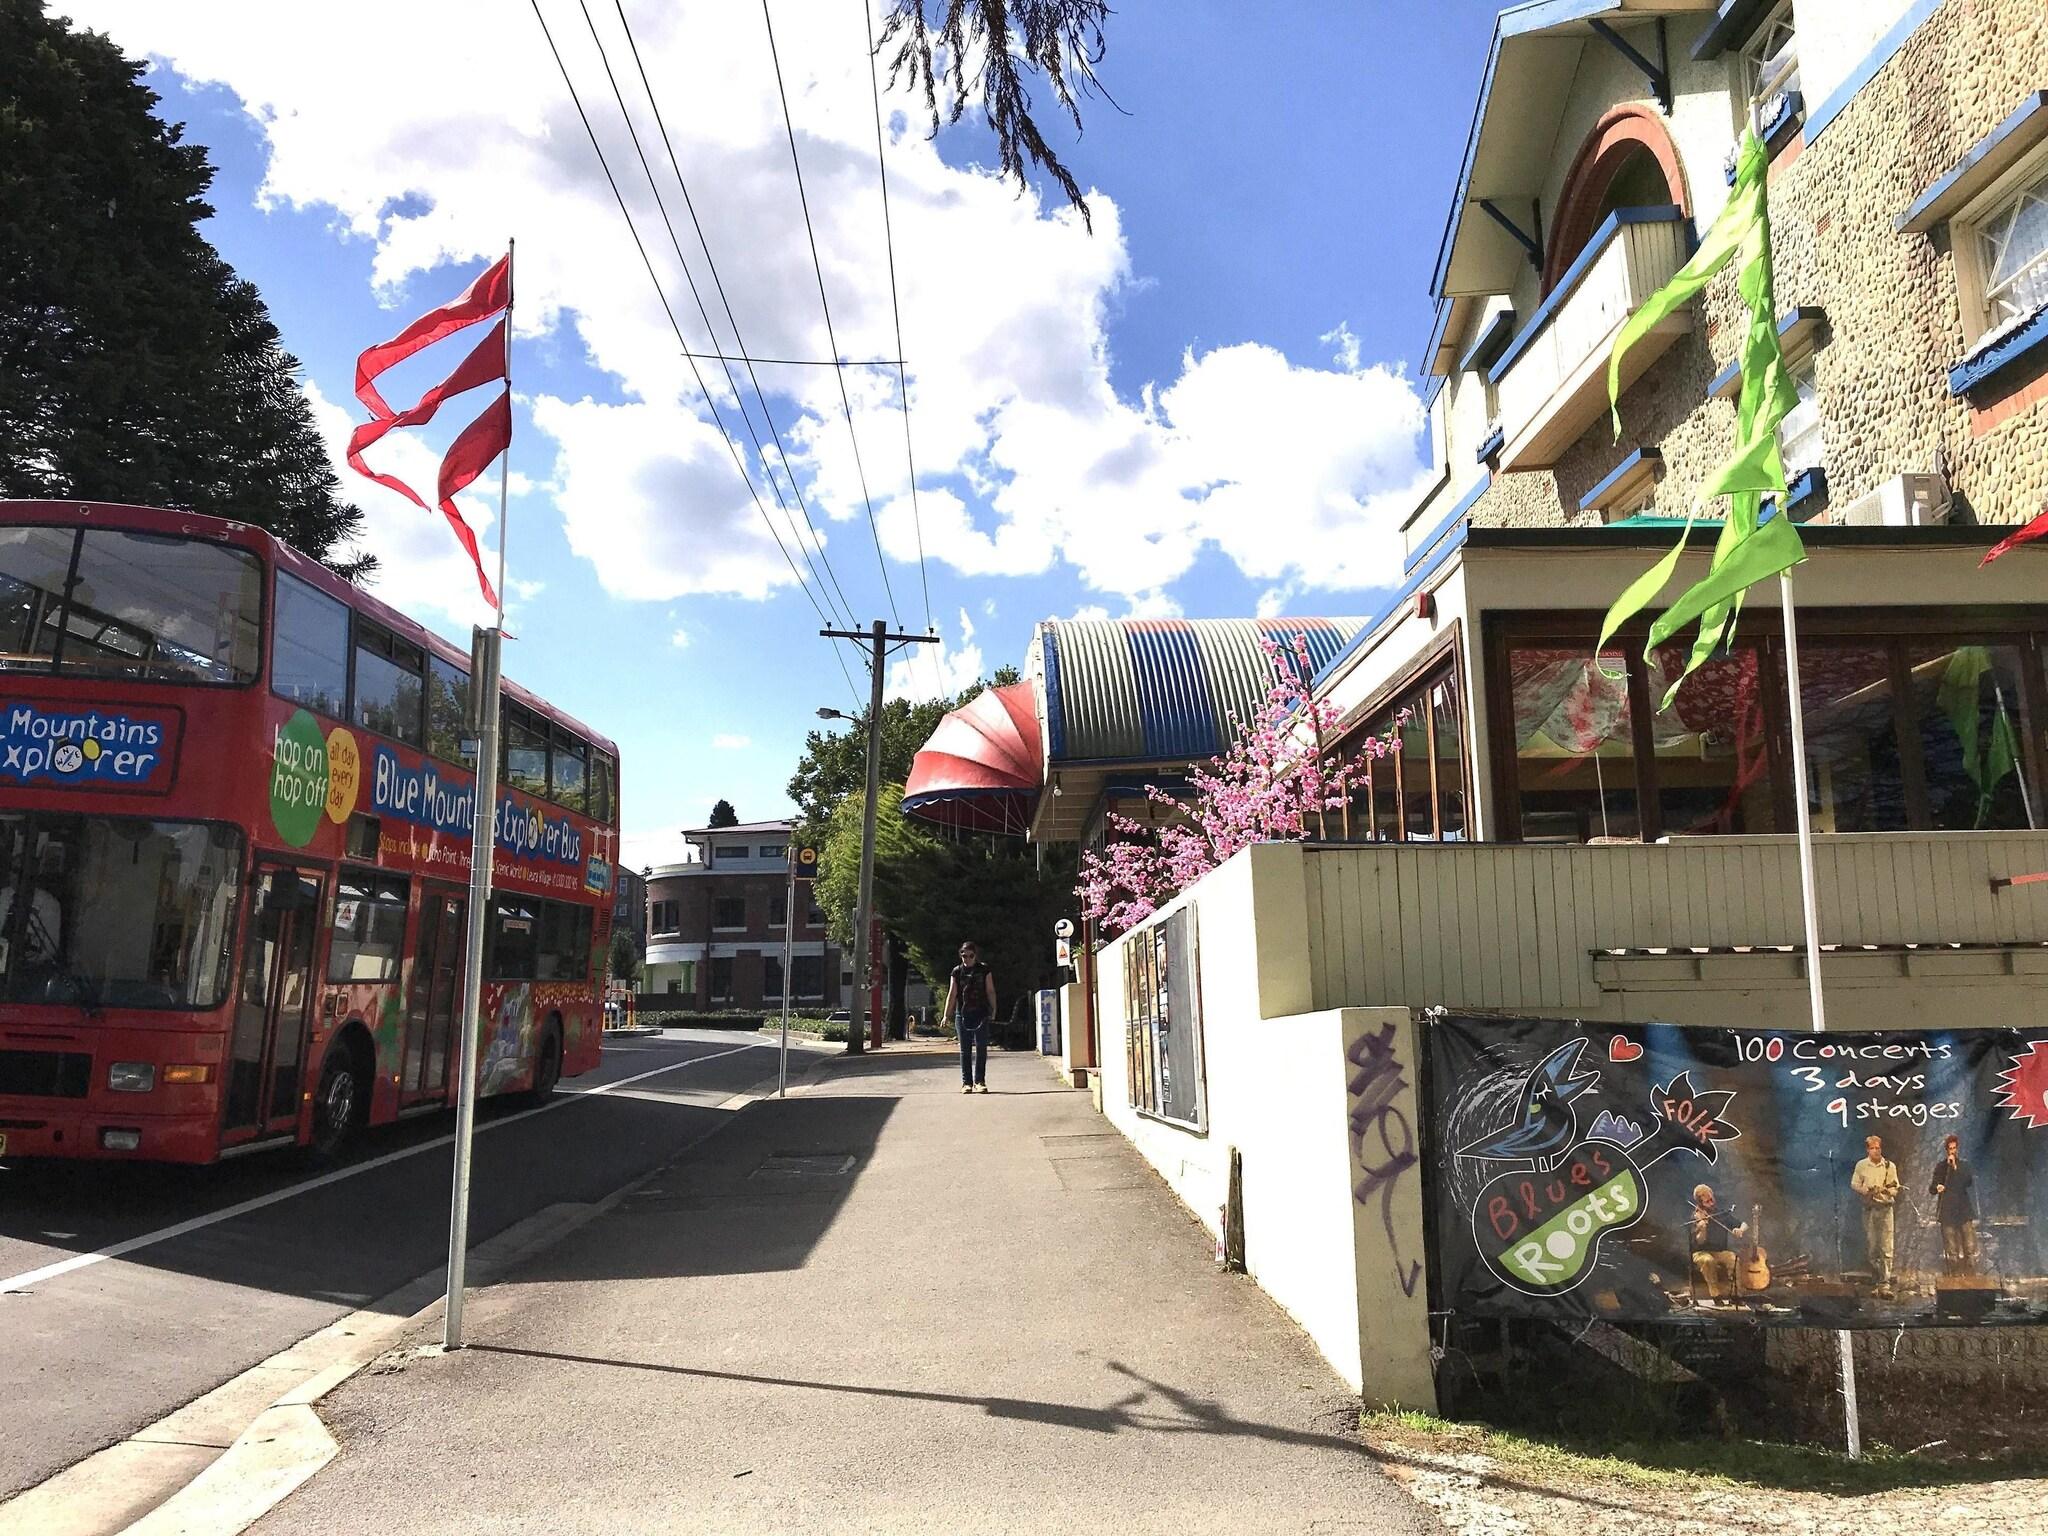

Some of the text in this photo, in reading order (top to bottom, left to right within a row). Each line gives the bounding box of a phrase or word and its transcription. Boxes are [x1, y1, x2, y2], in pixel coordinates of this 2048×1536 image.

[10, 709, 158, 745] Mountains
[0, 738, 154, 777] xplorer
[273, 723, 323, 774] hop on
[329, 741, 356, 770] all day
[273, 763, 328, 808] hop off
[332, 767, 354, 789] every
[329, 785, 345, 809] day
[375, 753, 580, 861] Blue Mounts Explorer Bus
[442, 845, 457, 865] Point
[1734, 1035, 1952, 1062] 100 Concerts
[1790, 1066, 1926, 1095] 3 days
[1663, 1099, 1720, 1144] FOLK
[1826, 1097, 1961, 1128] 9 stages
[1488, 1150, 1611, 1241] Blues
[1513, 1184, 1631, 1284] Roots
